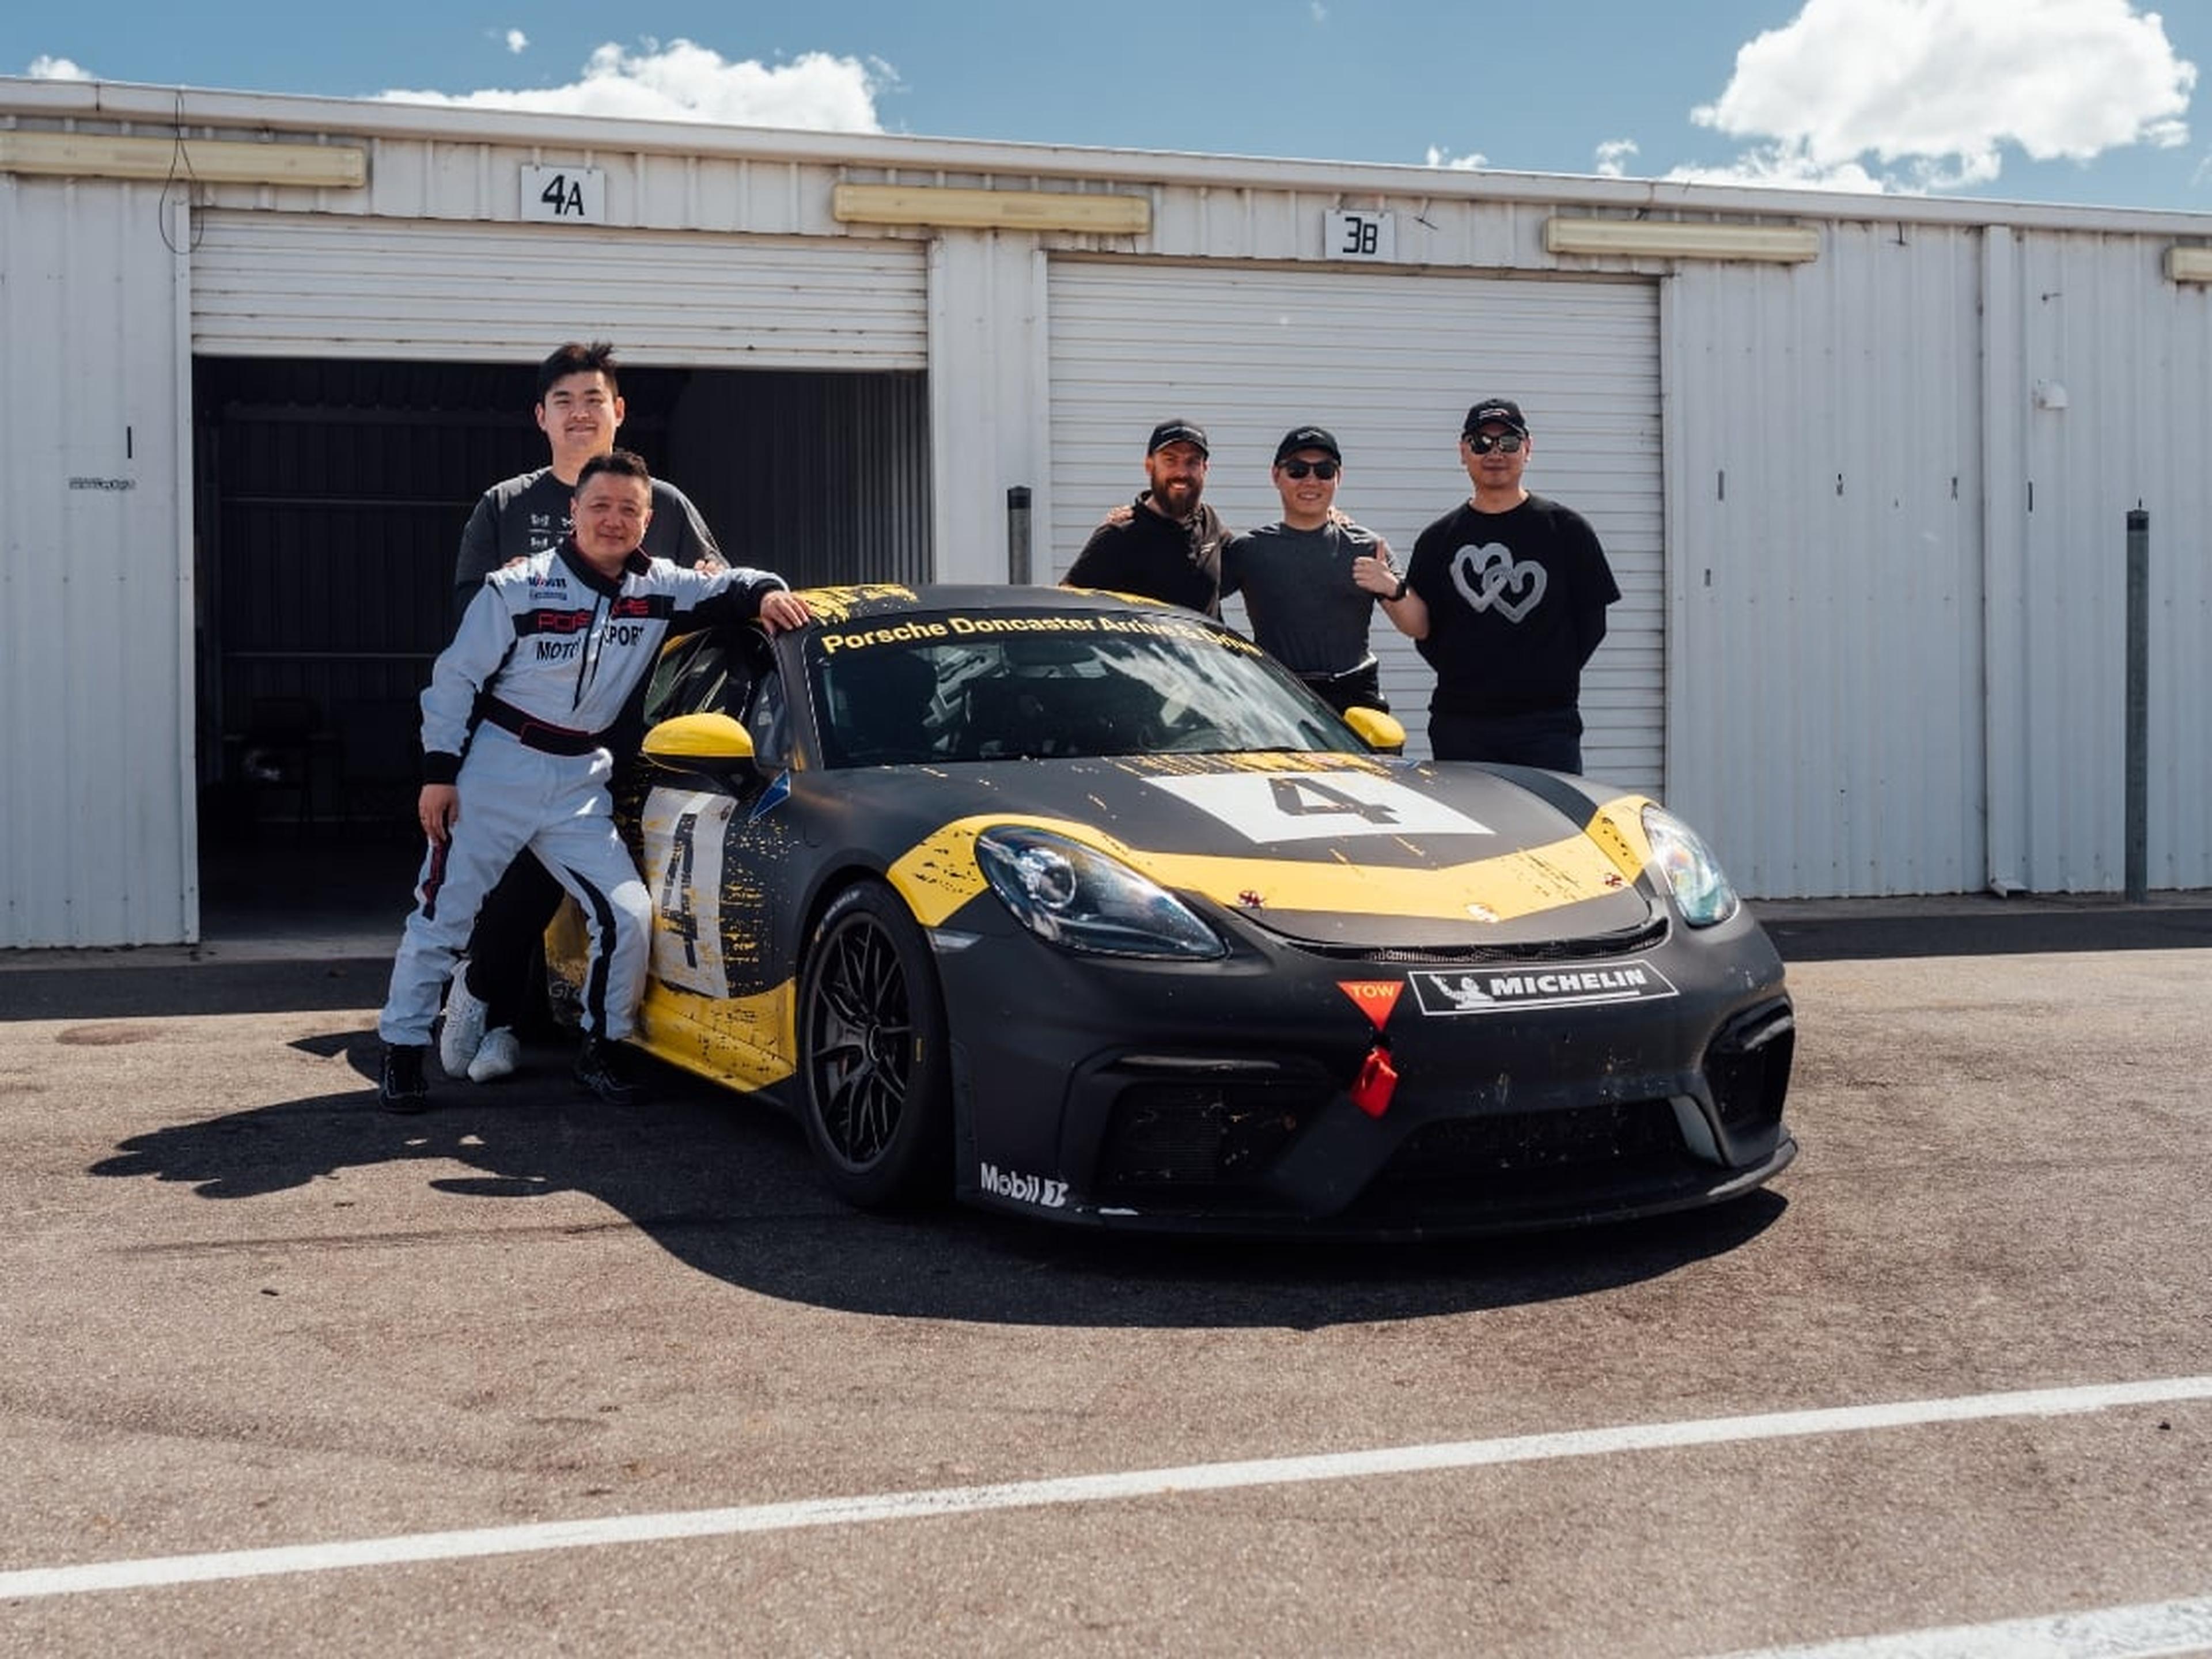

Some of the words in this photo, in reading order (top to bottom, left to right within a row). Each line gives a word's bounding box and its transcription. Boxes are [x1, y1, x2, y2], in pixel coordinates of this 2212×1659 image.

[541, 174, 585, 215] 4A
[1343, 217, 1377, 254] 3B
[821, 622, 948, 654] Porsche
[948, 616, 1097, 634] Doncaster
[1098, 616, 1176, 637] Arrive
[1267, 777, 1401, 824] 4
[661, 813, 699, 969] 4
[1352, 984, 1393, 998] TOW
[1490, 969, 1647, 996] MICHELIN
[980, 1162, 1039, 1203] Mobil
